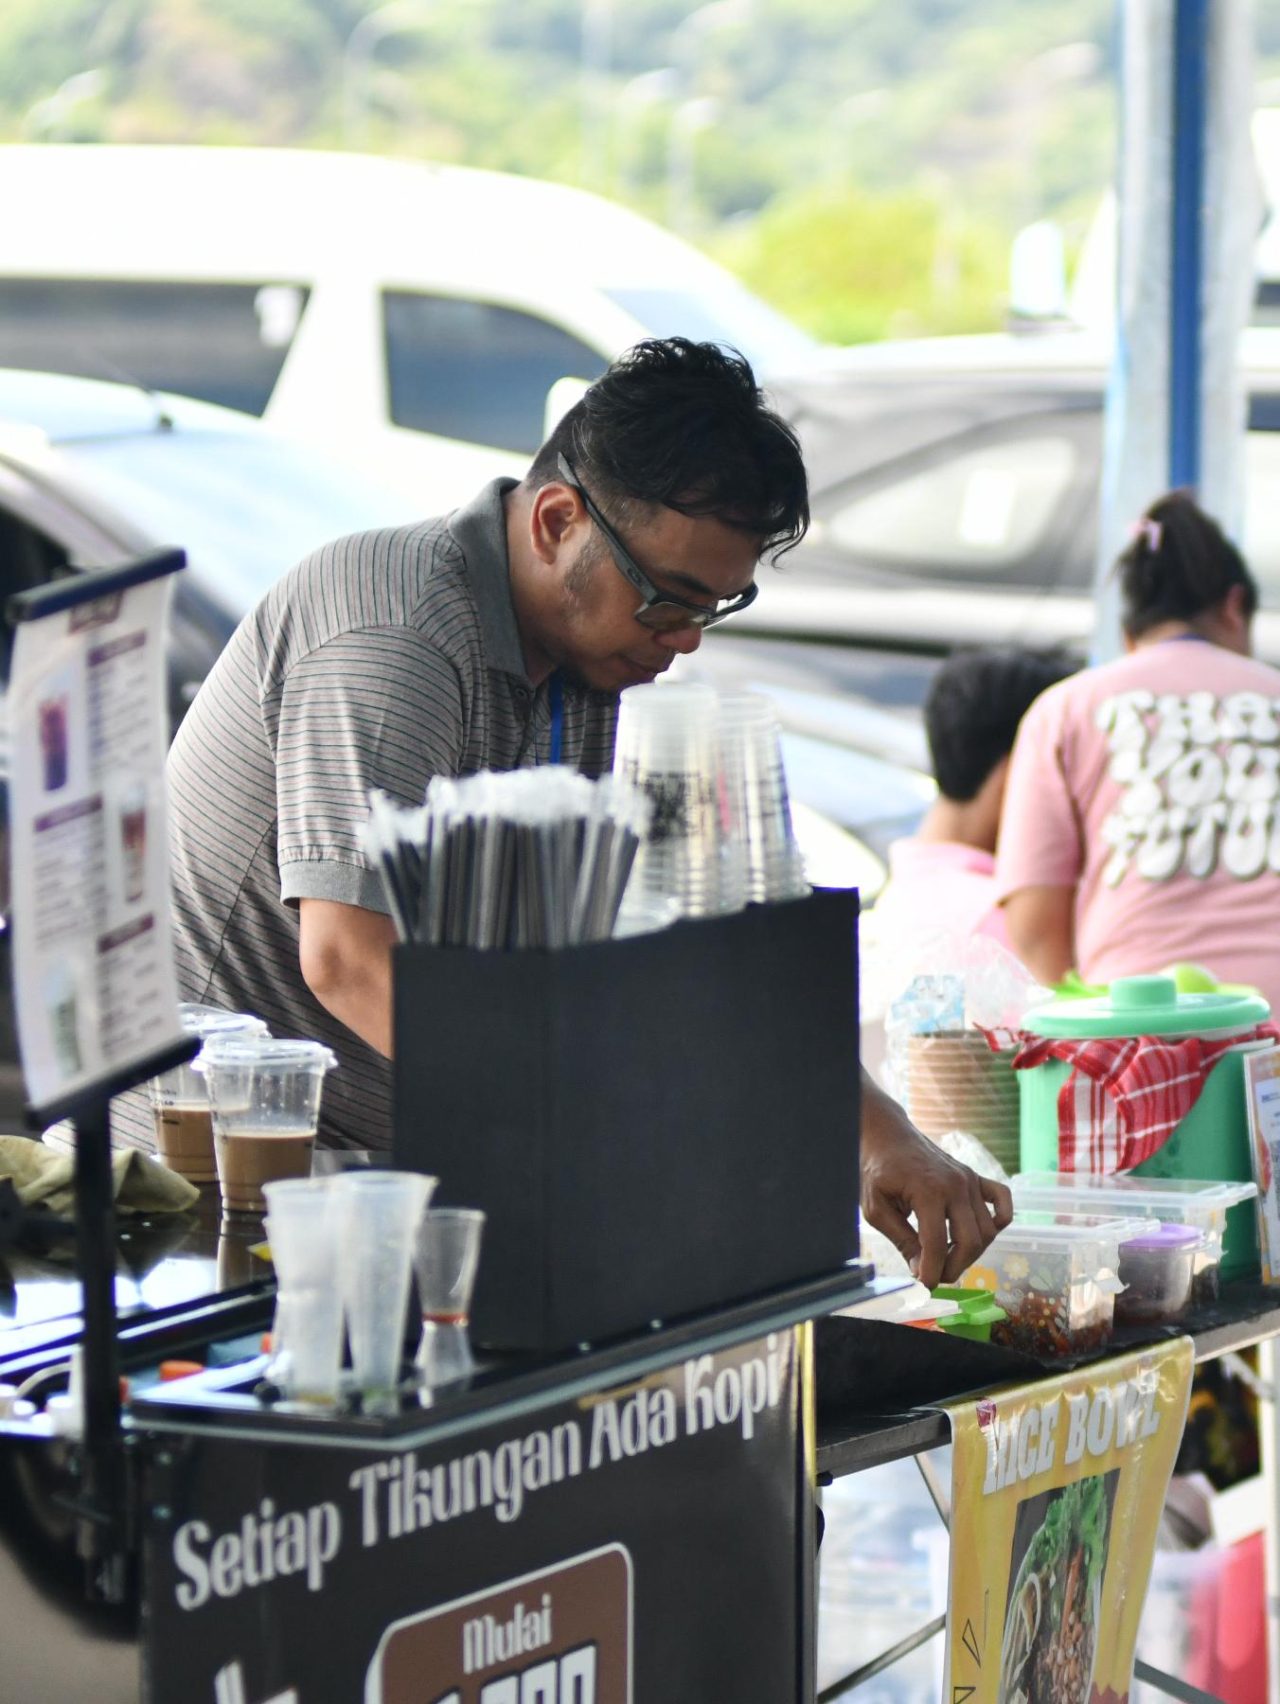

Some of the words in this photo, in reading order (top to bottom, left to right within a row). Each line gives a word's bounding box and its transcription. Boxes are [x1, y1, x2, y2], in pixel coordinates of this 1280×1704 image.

[173, 1498, 341, 1609] Setiap
[349, 1420, 580, 1547] Tikungan
[588, 1379, 678, 1469] Ada
[683, 1333, 782, 1439] Kopi
[983, 1401, 1060, 1495] RICE
[1065, 1371, 1160, 1465] BOWL
[462, 1594, 552, 1674] Mulai
